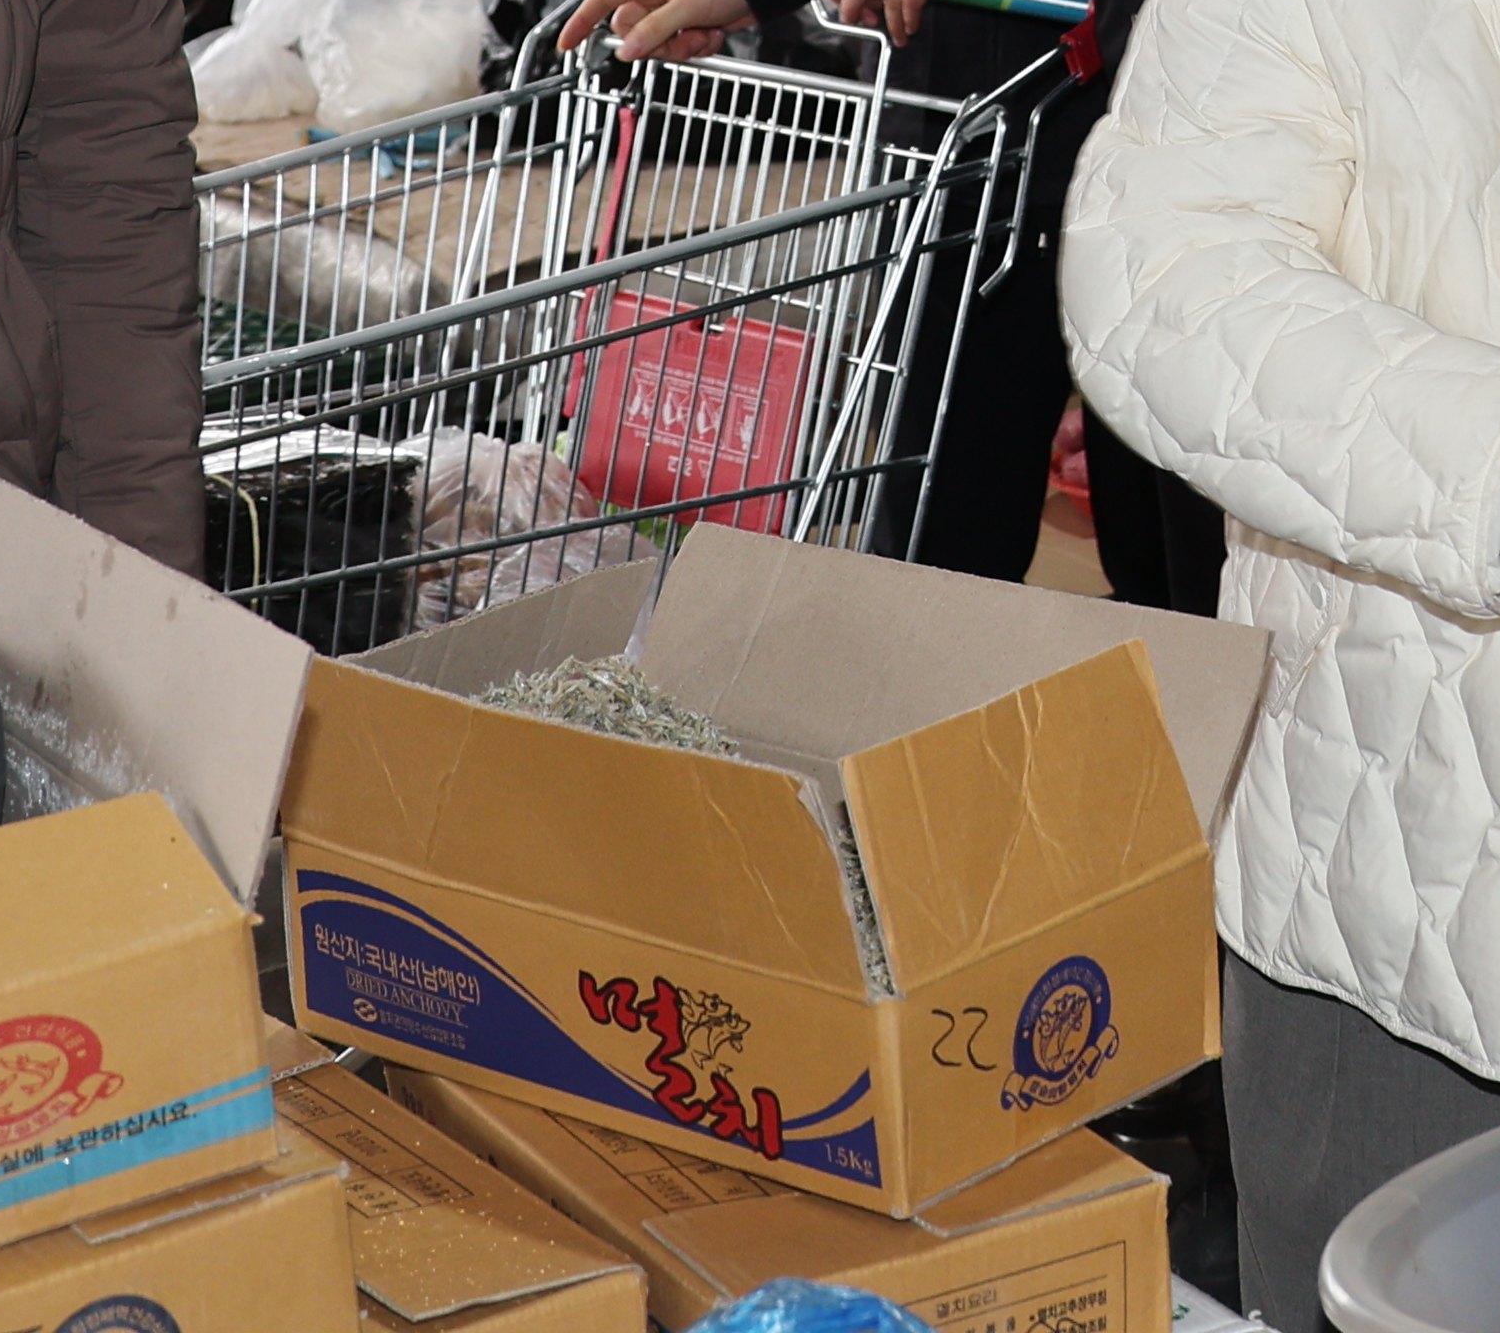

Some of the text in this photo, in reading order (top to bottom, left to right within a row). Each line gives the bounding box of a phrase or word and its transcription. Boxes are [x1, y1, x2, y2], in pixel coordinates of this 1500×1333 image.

[314, 923, 481, 1007] 원산지:국내산(남해안)
[347, 971, 467, 1024] DRIED ANCHOVY
[578, 969, 784, 1161] 멸치
[931, 1006, 998, 1071] 22
